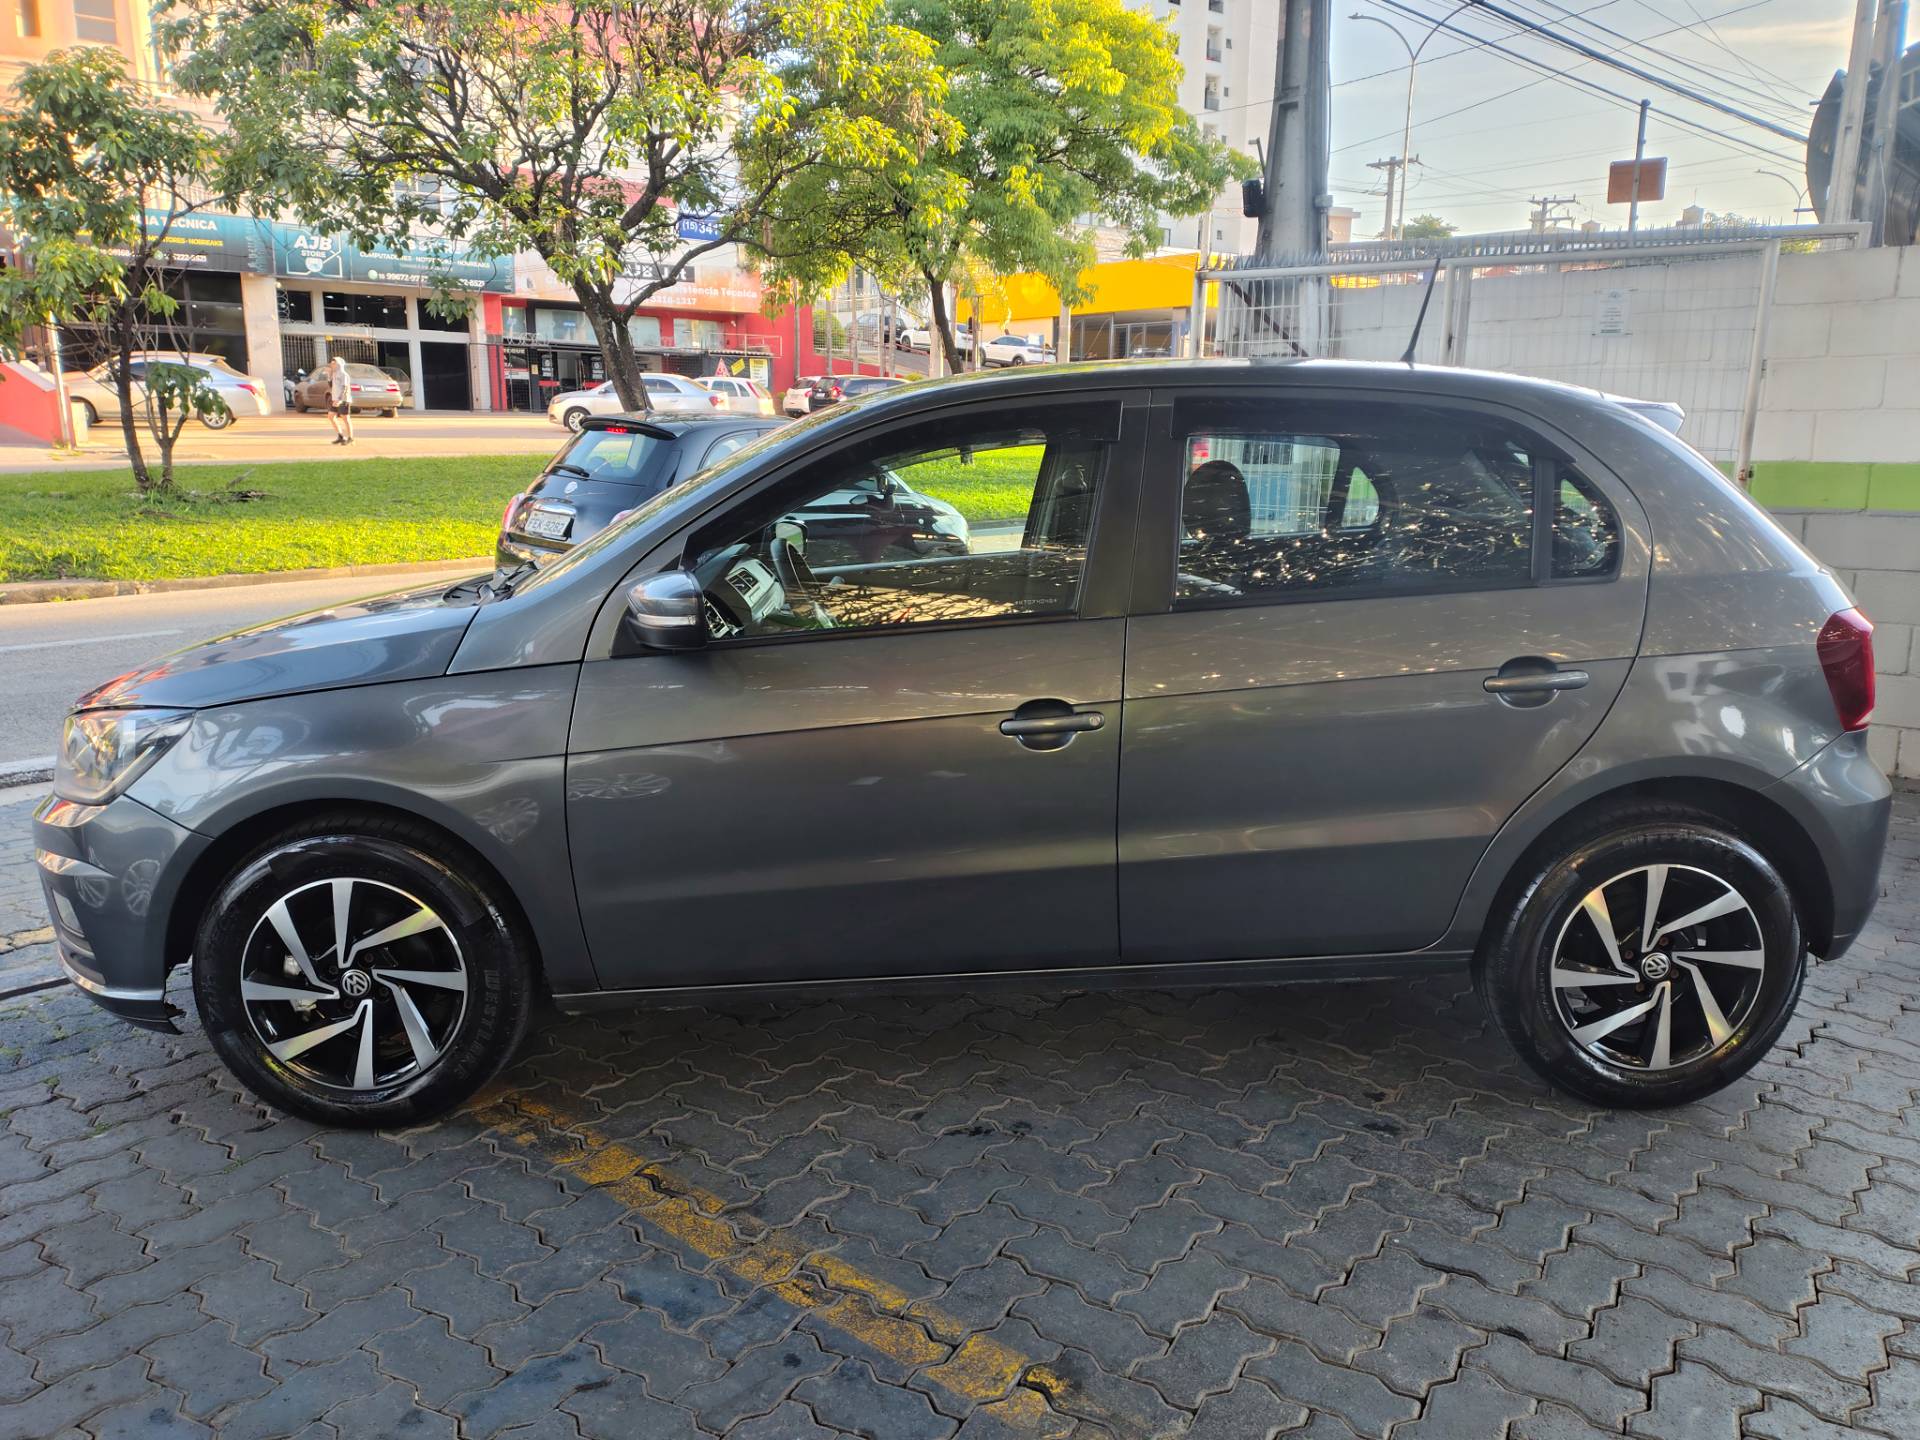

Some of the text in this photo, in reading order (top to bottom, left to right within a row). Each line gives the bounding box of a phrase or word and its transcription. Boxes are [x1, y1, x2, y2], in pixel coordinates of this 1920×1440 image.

[294, 235, 332, 251] AJB
[301, 250, 327, 258] STORE
[662, 266, 687, 280] Jt
